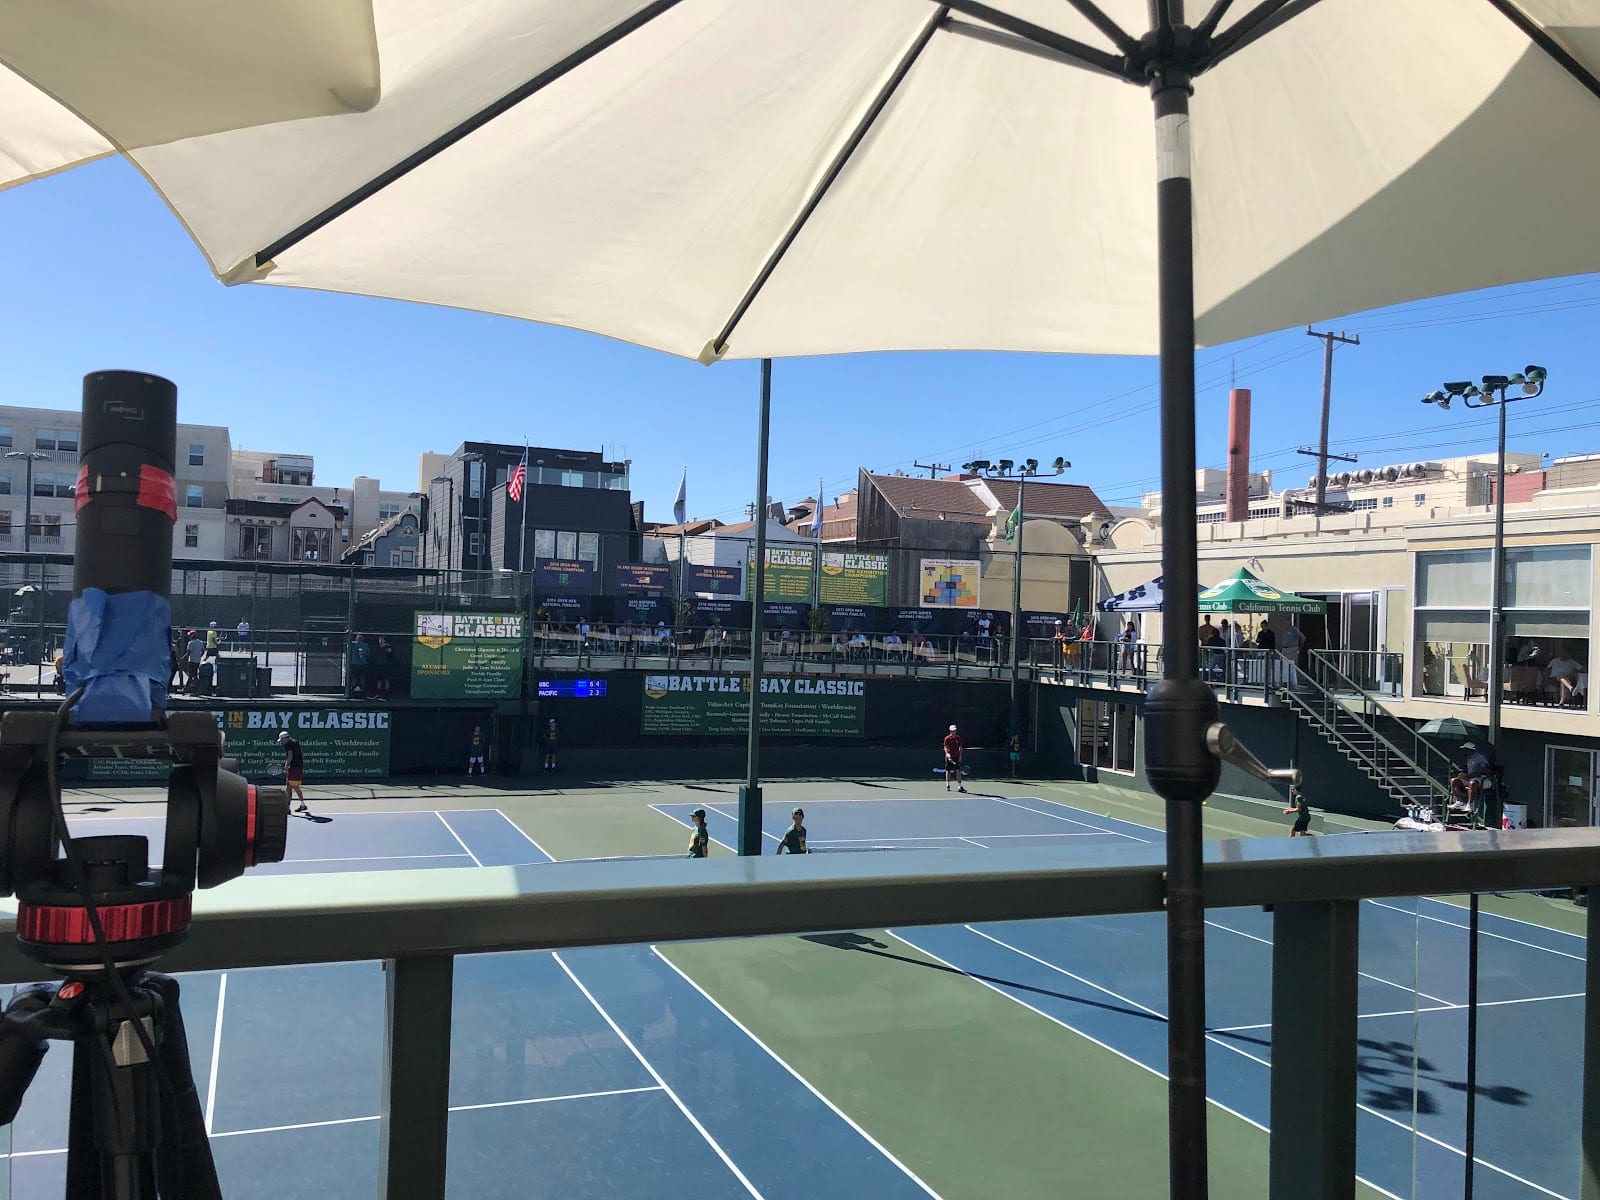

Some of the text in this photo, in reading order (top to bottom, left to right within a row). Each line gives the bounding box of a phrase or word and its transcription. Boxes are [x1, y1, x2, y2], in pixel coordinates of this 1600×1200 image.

[770, 555, 812, 566] CLASSIC
[845, 560, 888, 571] CLASSIC
[1212, 602, 1228, 611] Club
[1239, 602, 1321, 613] California Tennis Club
[455, 615, 493, 624] BATTLE
[503, 616, 521, 625] BAY
[455, 624, 521, 638] CLASSIC
[669, 676, 740, 692] BATTLE
[760, 678, 791, 693] BAY
[794, 679, 864, 696] CLASSIC
[227, 711, 244, 722] IN
[247, 711, 293, 729] BAY
[298, 711, 389, 729] CLASSIC
[223, 740, 245, 748] apital
